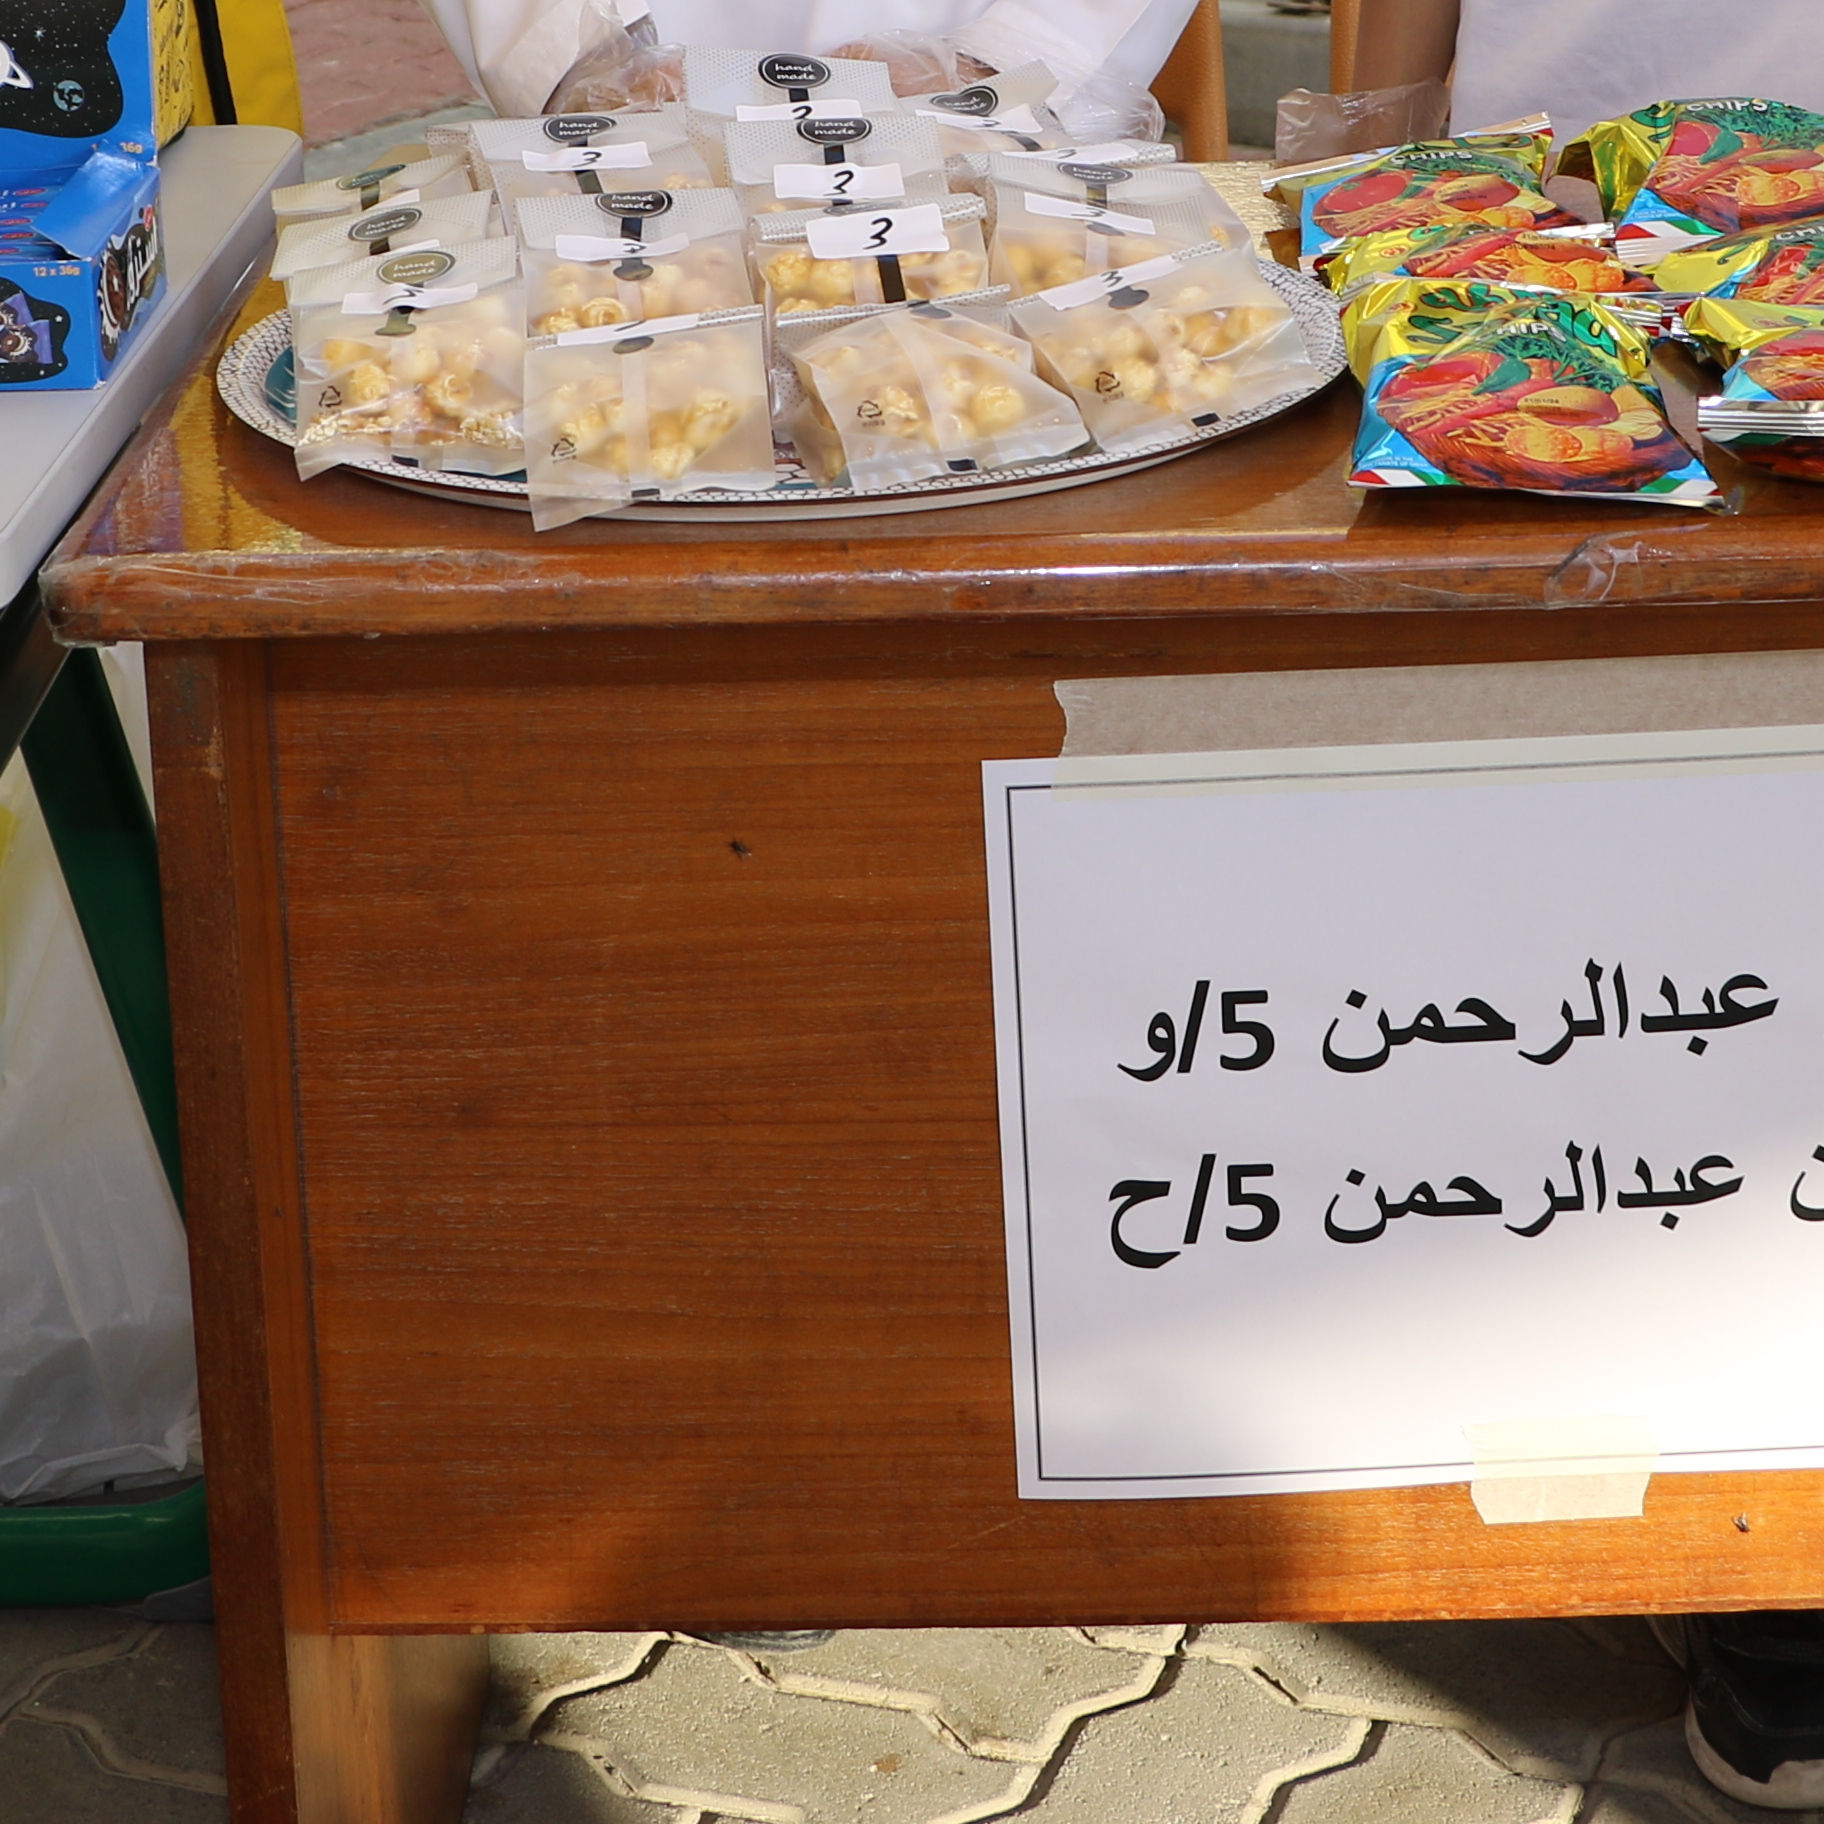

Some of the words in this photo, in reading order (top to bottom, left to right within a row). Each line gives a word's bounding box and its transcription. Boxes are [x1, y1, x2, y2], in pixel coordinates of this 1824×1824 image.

[775, 62, 816, 74] hand
[776, 72, 817, 81] made
[1686, 97, 1769, 114] CHIPS
[572, 151, 602, 168] 3
[1389, 150, 1474, 166] CHIPS
[824, 170, 854, 197] 3
[862, 217, 894, 251] 3
[33, 266, 47, 277] 12
[59, 266, 80, 277] 36g
[393, 259, 438, 272] hand
[1322, 958, 1779, 1074] عبدالرحمن
[1117, 979, 1275, 1082] 5/و
[1324, 1139, 1744, 1245] عبدالرحمن
[1108, 1153, 1280, 1269] 5/ح
